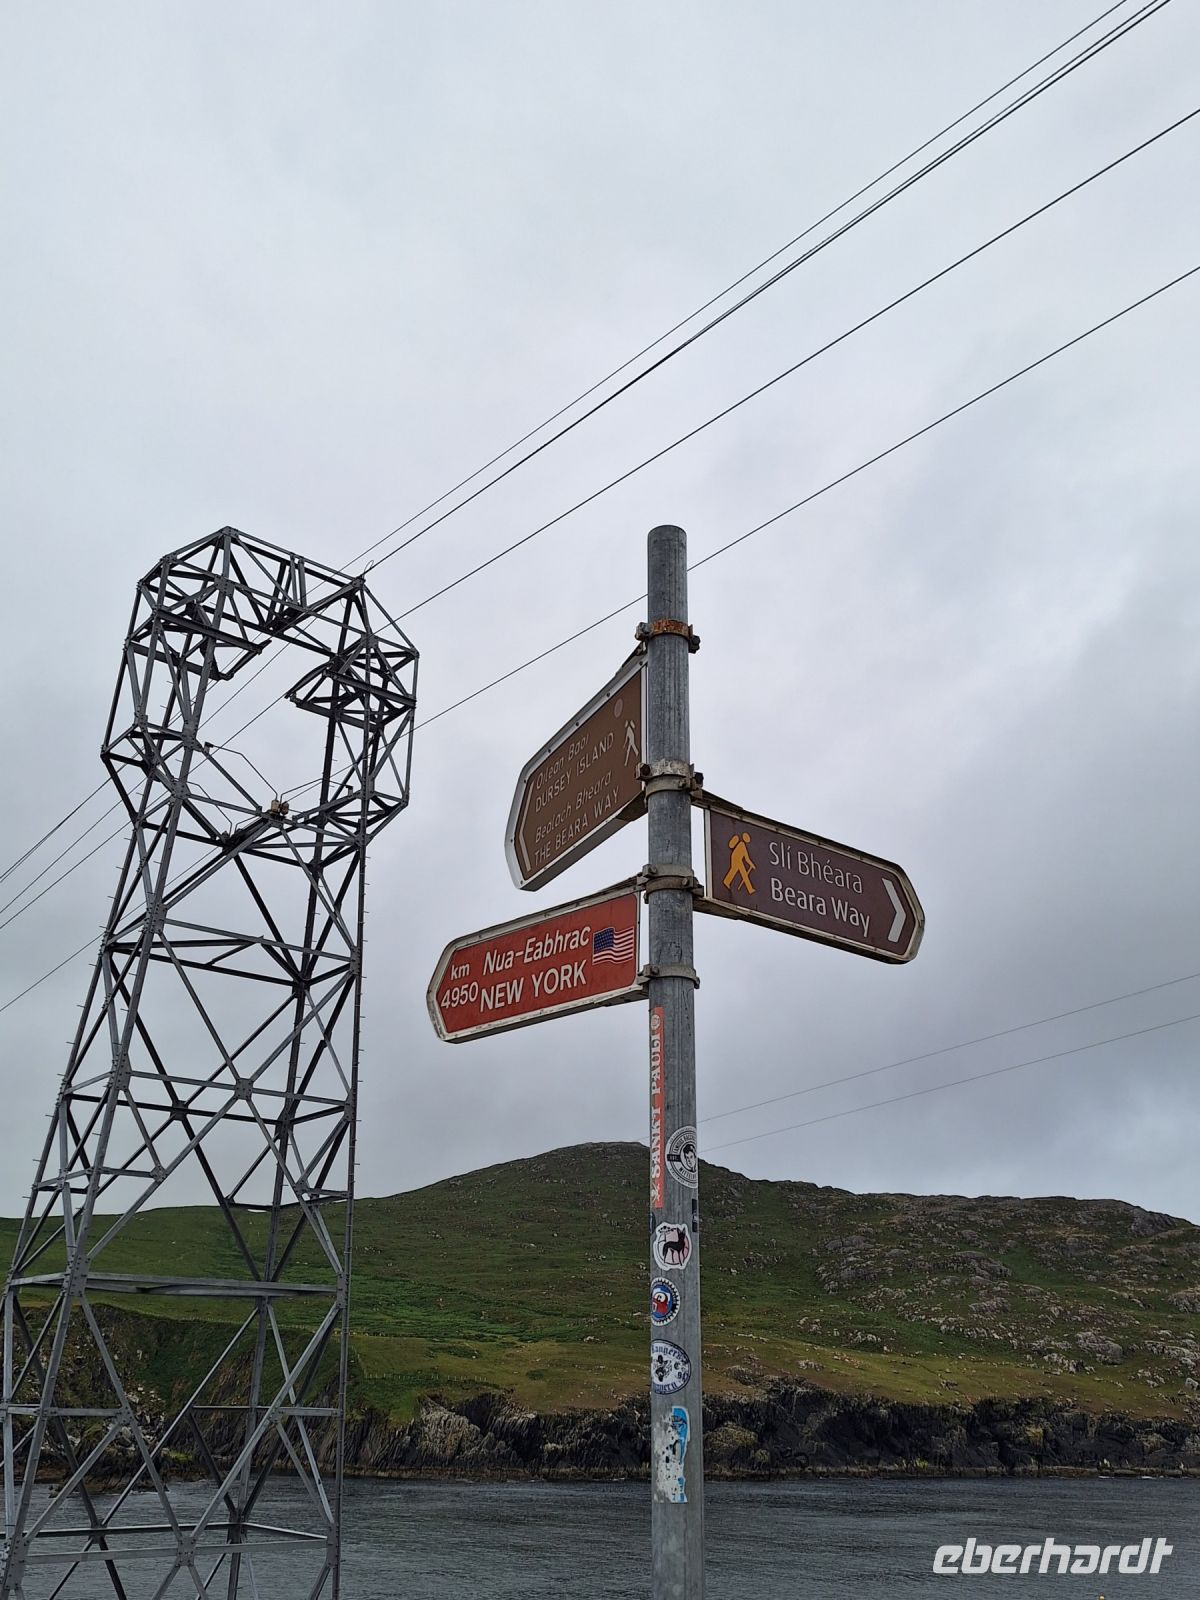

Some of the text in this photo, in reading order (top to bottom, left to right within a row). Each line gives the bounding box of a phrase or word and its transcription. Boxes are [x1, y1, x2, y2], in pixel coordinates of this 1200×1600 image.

[535, 732, 615, 812] DURSEY ISLAND
[534, 785, 620, 866] THE BEARA WAY
[535, 803, 572, 843] Bealach
[769, 841, 863, 894] Slí Bhéara
[771, 877, 870, 937] Beara Way
[450, 962, 470, 981] km
[482, 926, 592, 976] Nua-Eabhrac
[441, 982, 479, 1009] 4950
[479, 959, 587, 1012] NEW YORK
